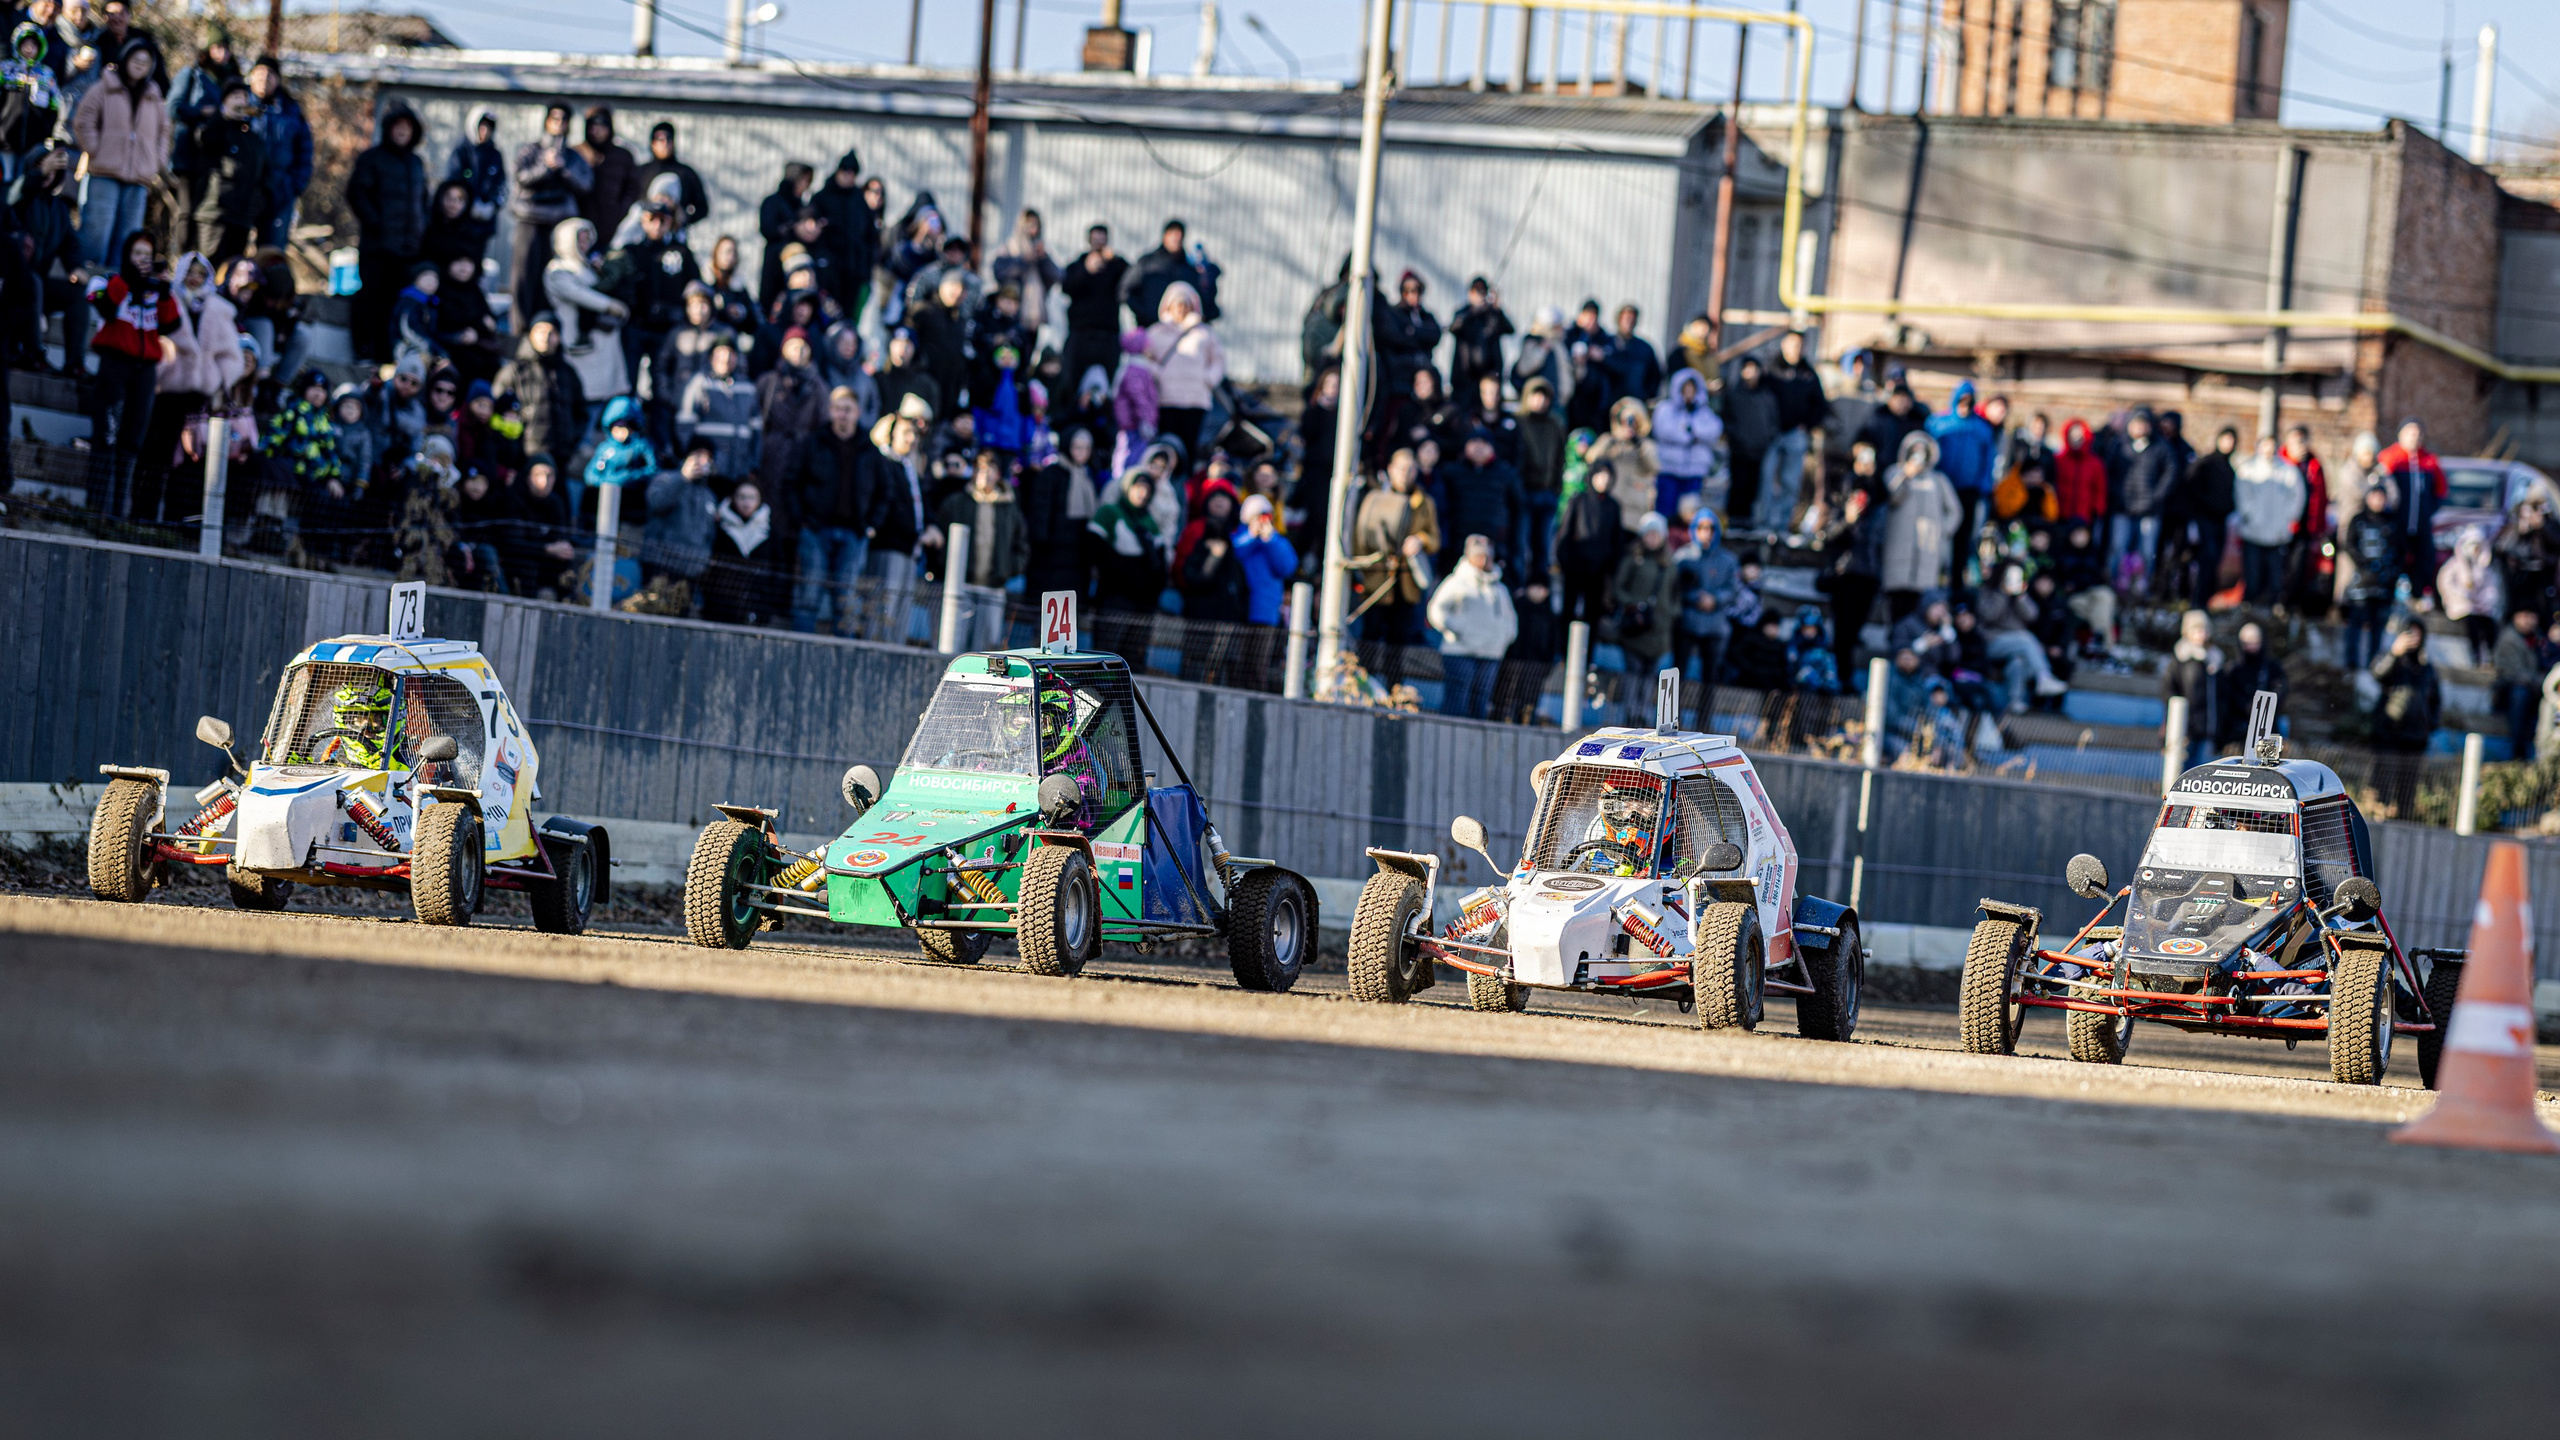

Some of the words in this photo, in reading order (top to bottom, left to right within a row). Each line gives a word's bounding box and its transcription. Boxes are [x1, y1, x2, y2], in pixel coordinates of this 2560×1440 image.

[397, 589, 417, 635] 73
[1047, 596, 1071, 643] 24
[481, 690, 519, 738] 73
[1661, 676, 1675, 724] 71
[2251, 695, 2272, 748] 14
[909, 774, 1021, 794] НОВОСИБИРСК
[2180, 778, 2290, 799] НОВОСИБИРСК
[860, 832, 928, 847] 24
[1094, 843, 1122, 858] Иванова
[1122, 846, 1140, 860] Лера
